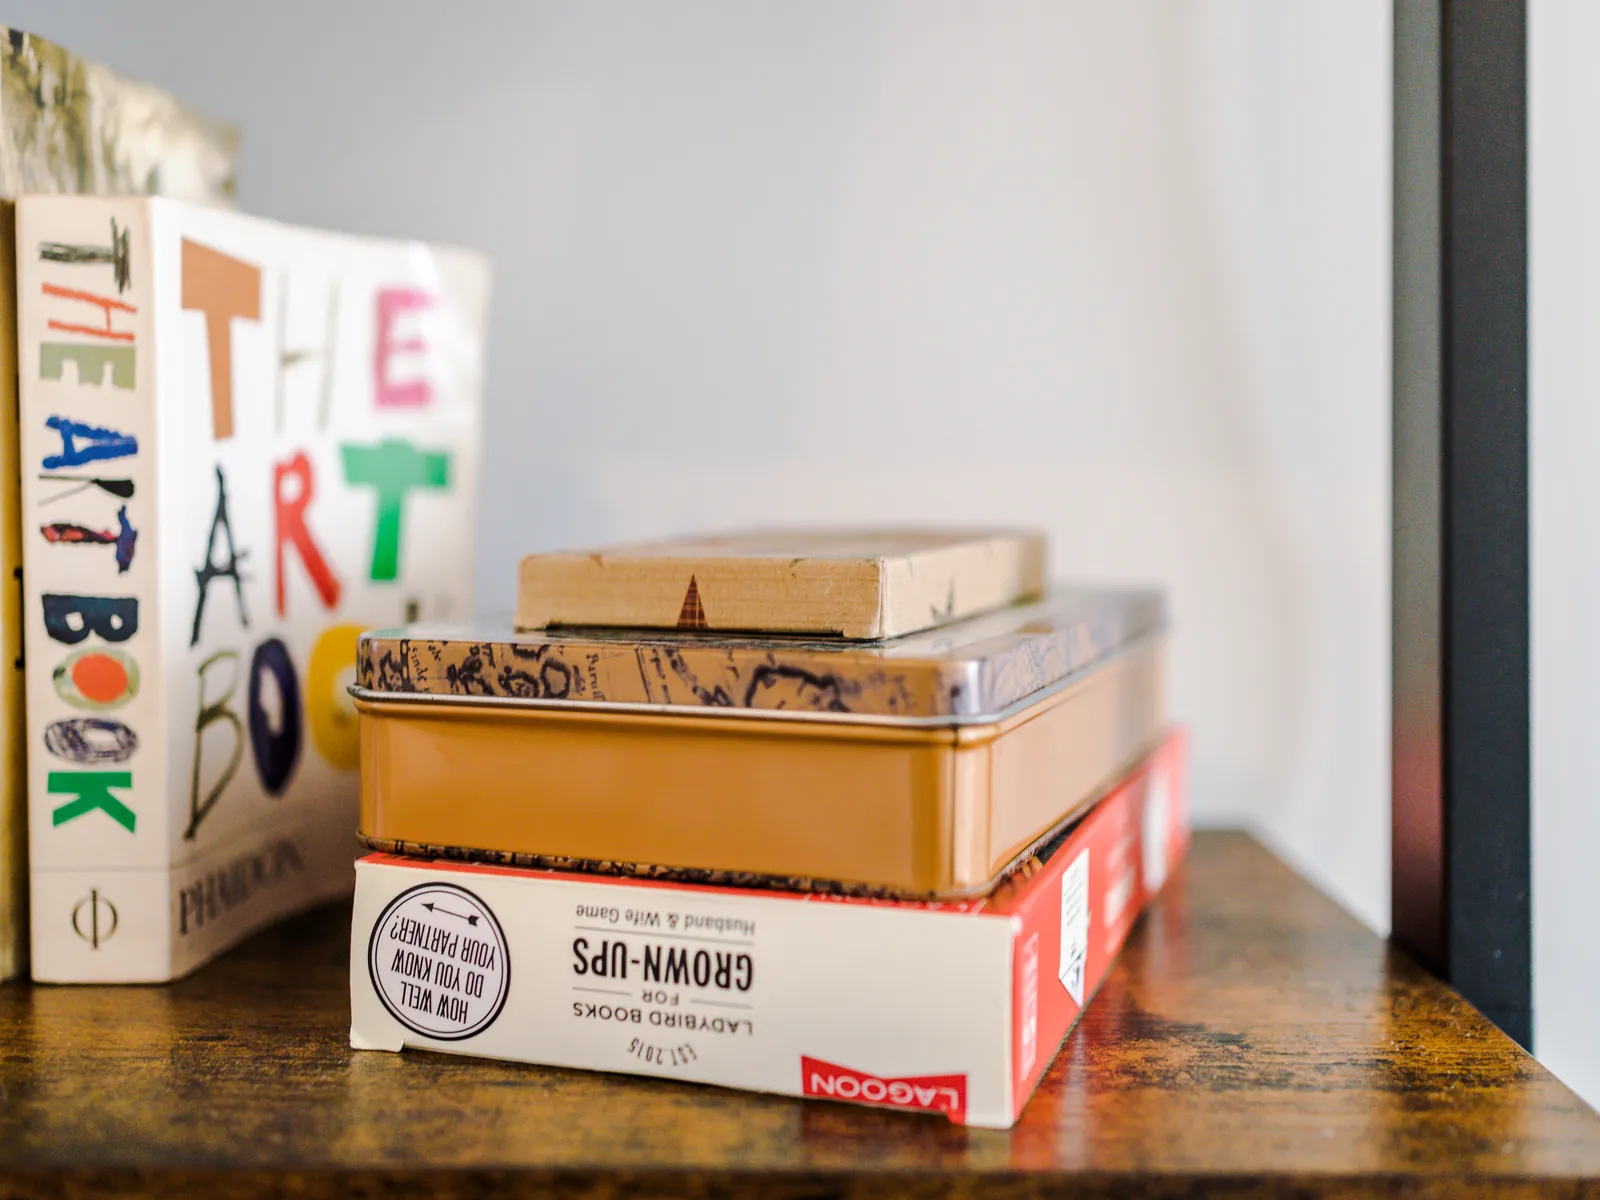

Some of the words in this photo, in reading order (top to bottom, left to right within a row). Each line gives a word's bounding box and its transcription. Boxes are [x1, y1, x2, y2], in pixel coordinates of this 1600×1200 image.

[38, 216, 138, 392] THE
[180, 234, 437, 440] THE
[38, 415, 139, 575] ART
[190, 436, 453, 648] ART
[41, 592, 141, 835] BOOK
[183, 622, 420, 842] BOO
[575, 904, 620, 925] Game
[624, 908, 661, 928] Wife
[666, 912, 680, 930] &
[683, 914, 757, 936] Husband
[389, 914, 460, 959] PARTNER?
[390, 948, 433, 983] KNOW
[460, 936, 497, 972] YOUR
[572, 937, 753, 992] GROWN-UPS
[433, 961, 461, 992] YOU
[465, 970, 485, 999] DO
[400, 980, 432, 1014] WELL
[435, 993, 469, 1024] HOW
[572, 1001, 643, 1024] BOOKS
[641, 989, 681, 1006] FOR
[648, 1010, 754, 1037] LADYBIRD
[809, 1072, 960, 1112] LAGOON
